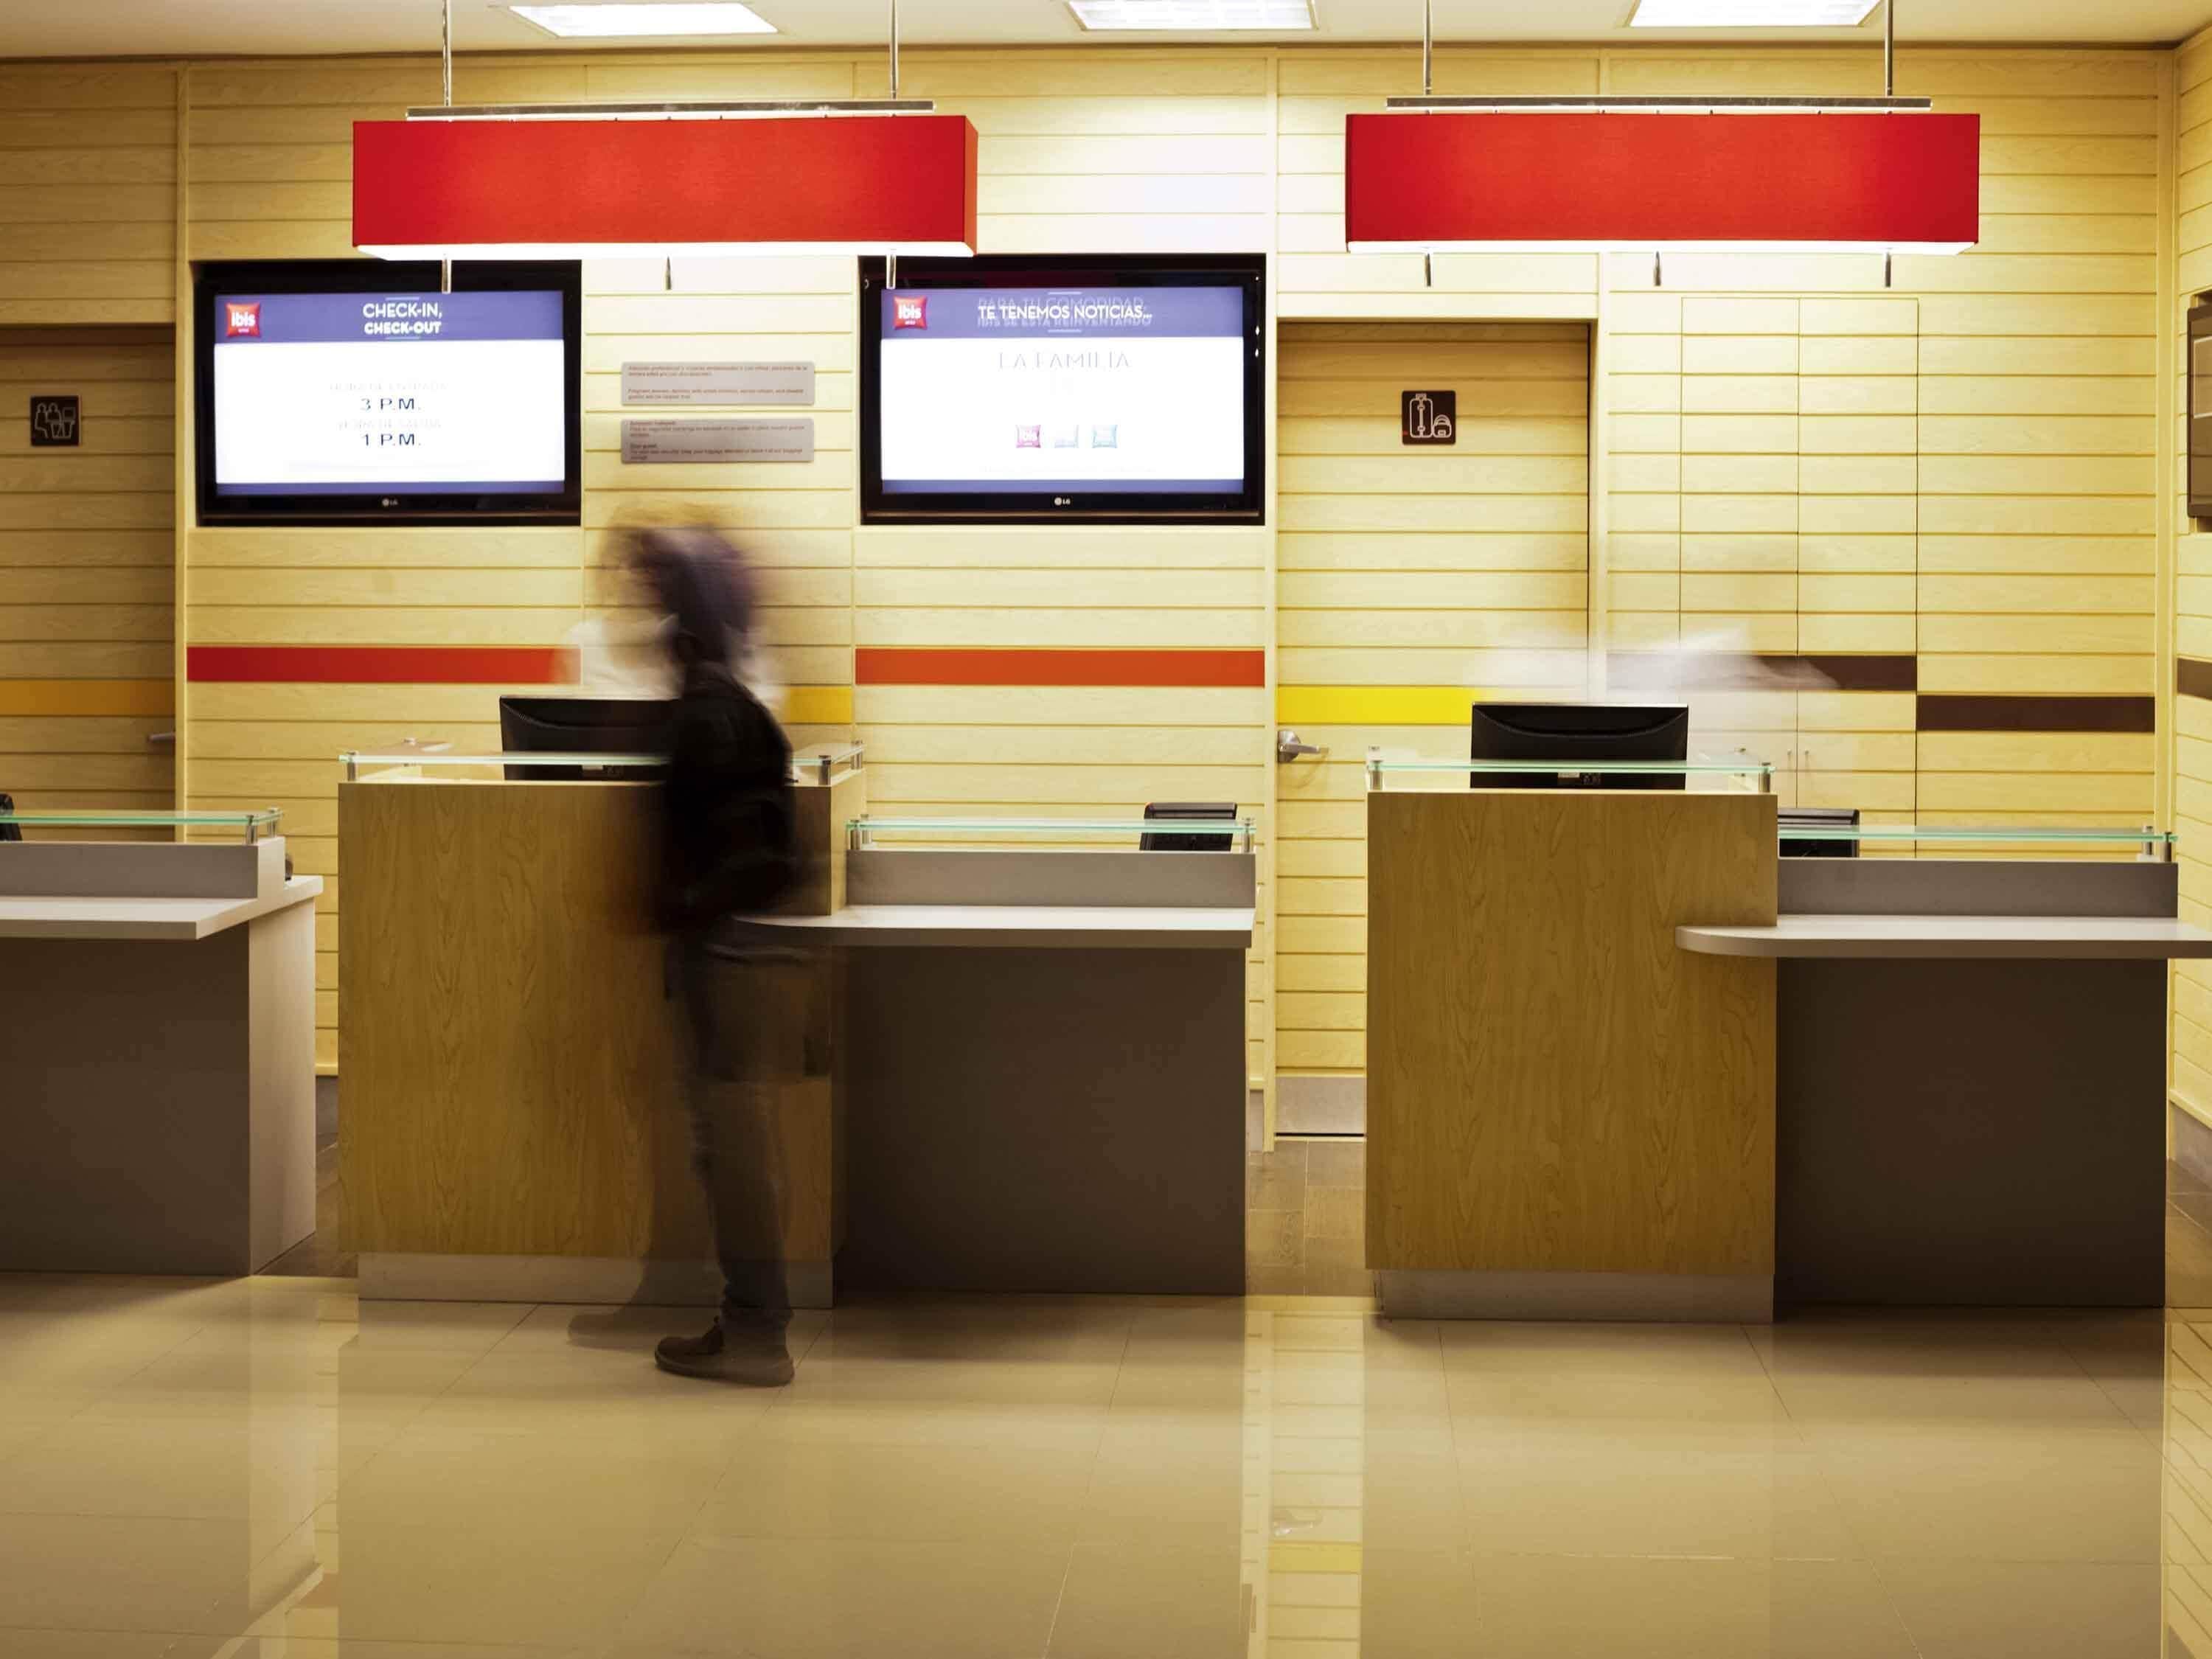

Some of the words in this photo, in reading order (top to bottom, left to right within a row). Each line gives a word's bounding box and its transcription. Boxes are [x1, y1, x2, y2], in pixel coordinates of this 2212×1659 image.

[363, 302, 442, 319] CHECK-IN,
[898, 303, 922, 319] ibis
[978, 306, 995, 319] TE
[999, 306, 1070, 319] TENEMOS
[1074, 305, 1152, 319] NOTICIAS...
[231, 310, 256, 327] ibis
[364, 321, 442, 334] CHECK-OUT
[1035, 351, 1130, 368] FAMILIA
[361, 398, 371, 411] 3
[380, 398, 422, 411] P.M.
[361, 433, 369, 446] 1
[380, 433, 422, 446] P.M.
